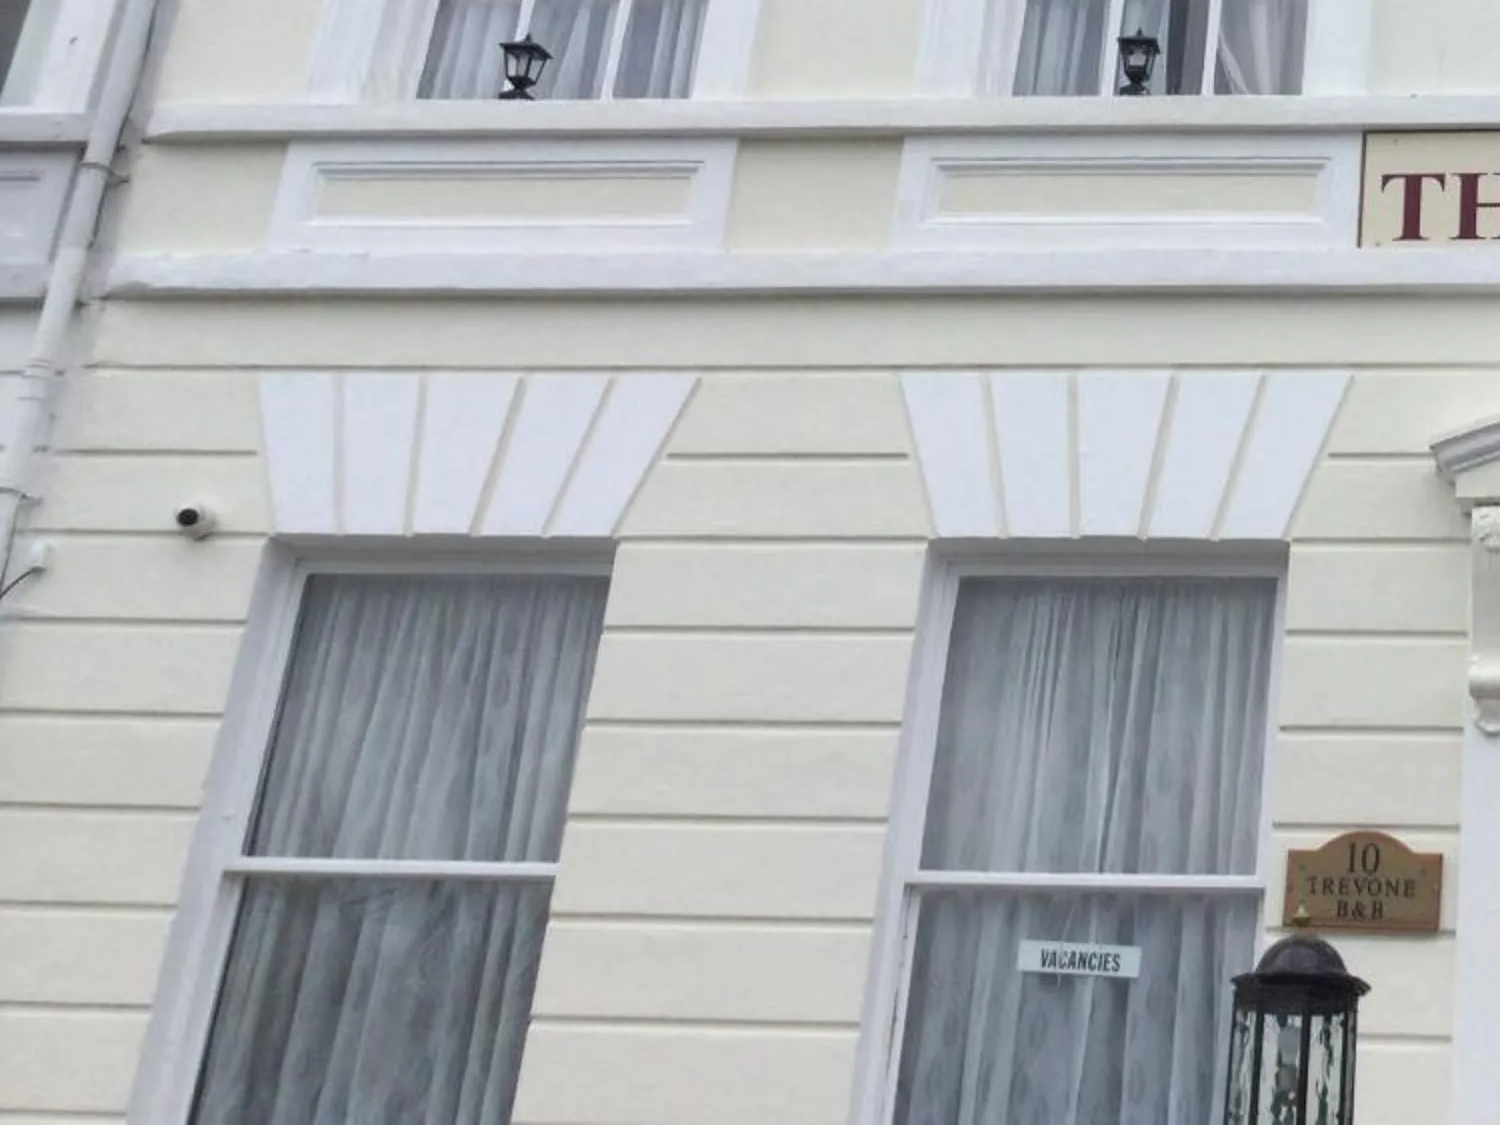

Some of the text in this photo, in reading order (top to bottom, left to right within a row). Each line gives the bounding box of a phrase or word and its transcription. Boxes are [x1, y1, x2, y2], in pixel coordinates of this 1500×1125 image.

[1347, 842, 1381, 876] 10
[1307, 876, 1417, 899] TREVONE
[1040, 948, 1122, 973] VACANCIES
